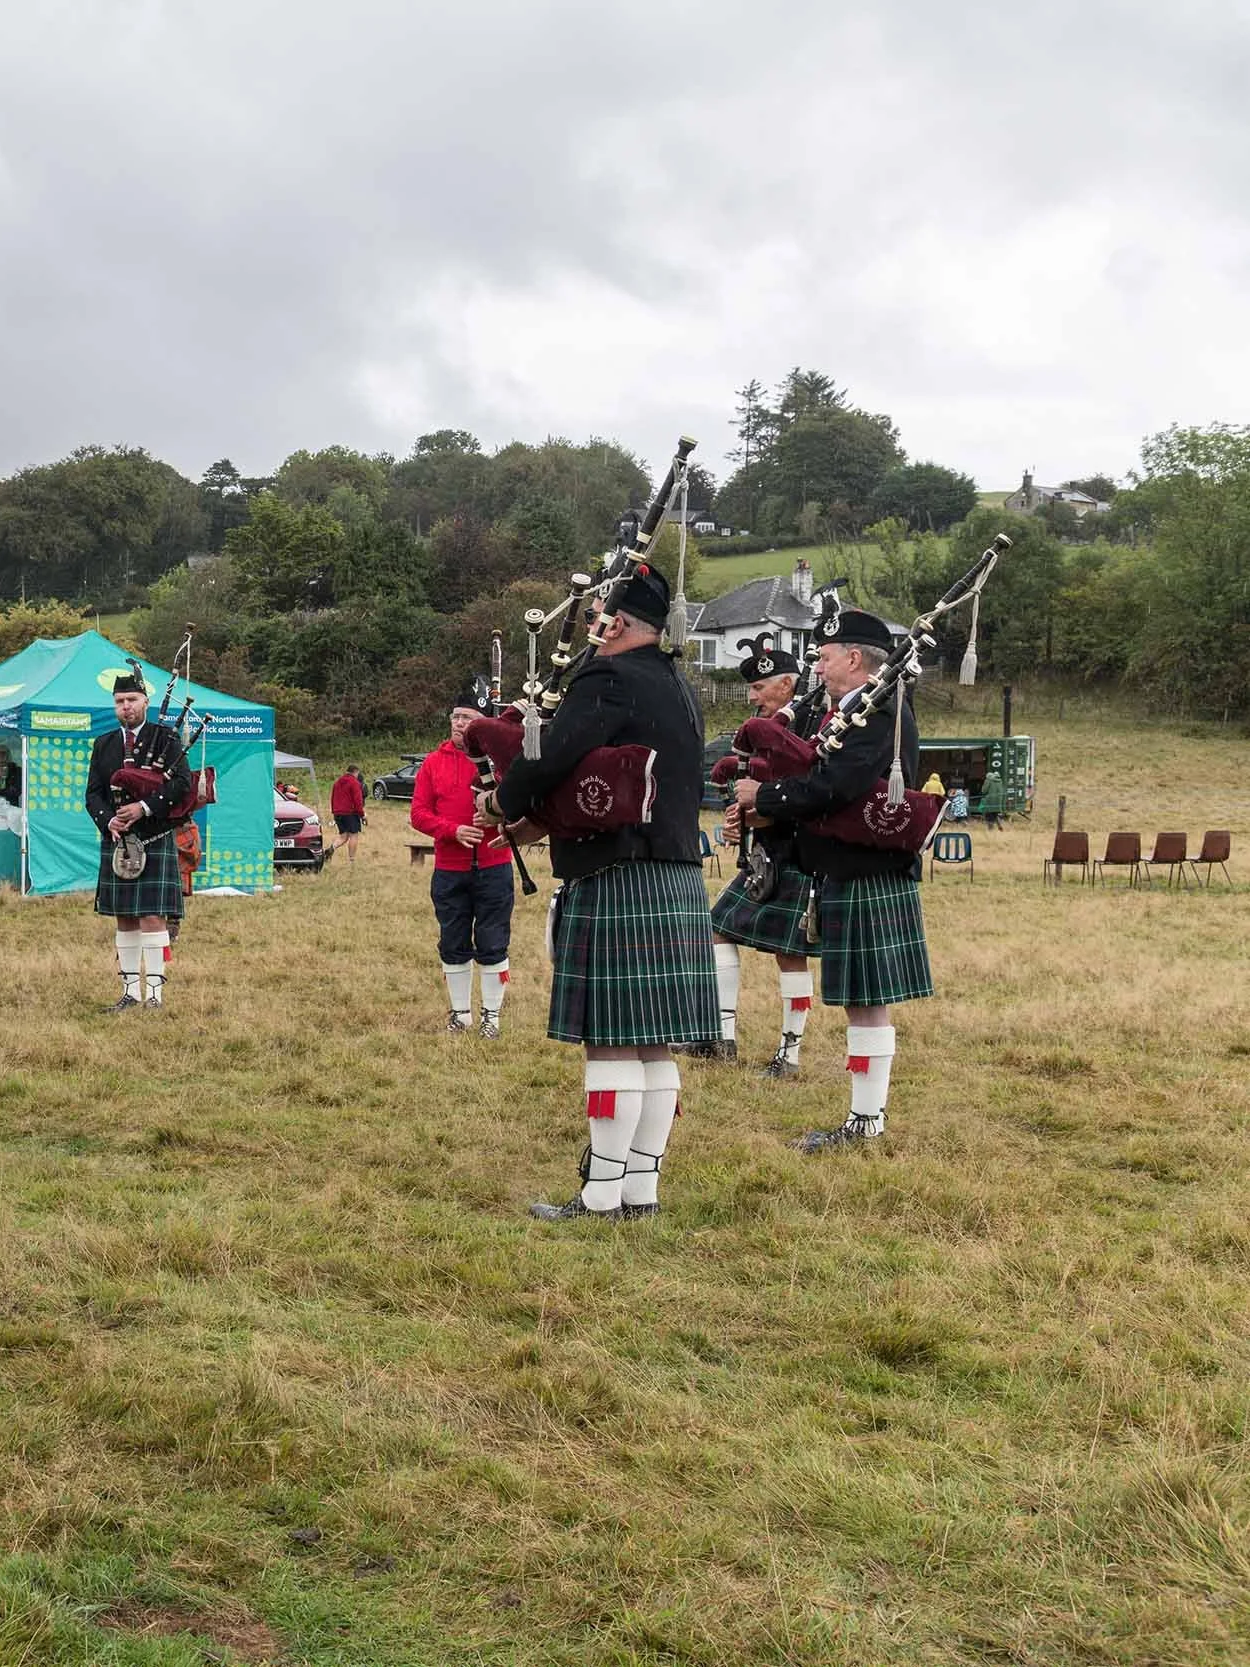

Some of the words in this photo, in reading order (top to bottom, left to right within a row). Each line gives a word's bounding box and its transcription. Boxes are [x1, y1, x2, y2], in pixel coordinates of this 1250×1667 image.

[212, 715, 263, 724] Northumbria,
[218, 726, 233, 734] and
[234, 726, 263, 734] Borders
[579, 775, 611, 791] Rothbury
[875, 792, 912, 813] Roury
